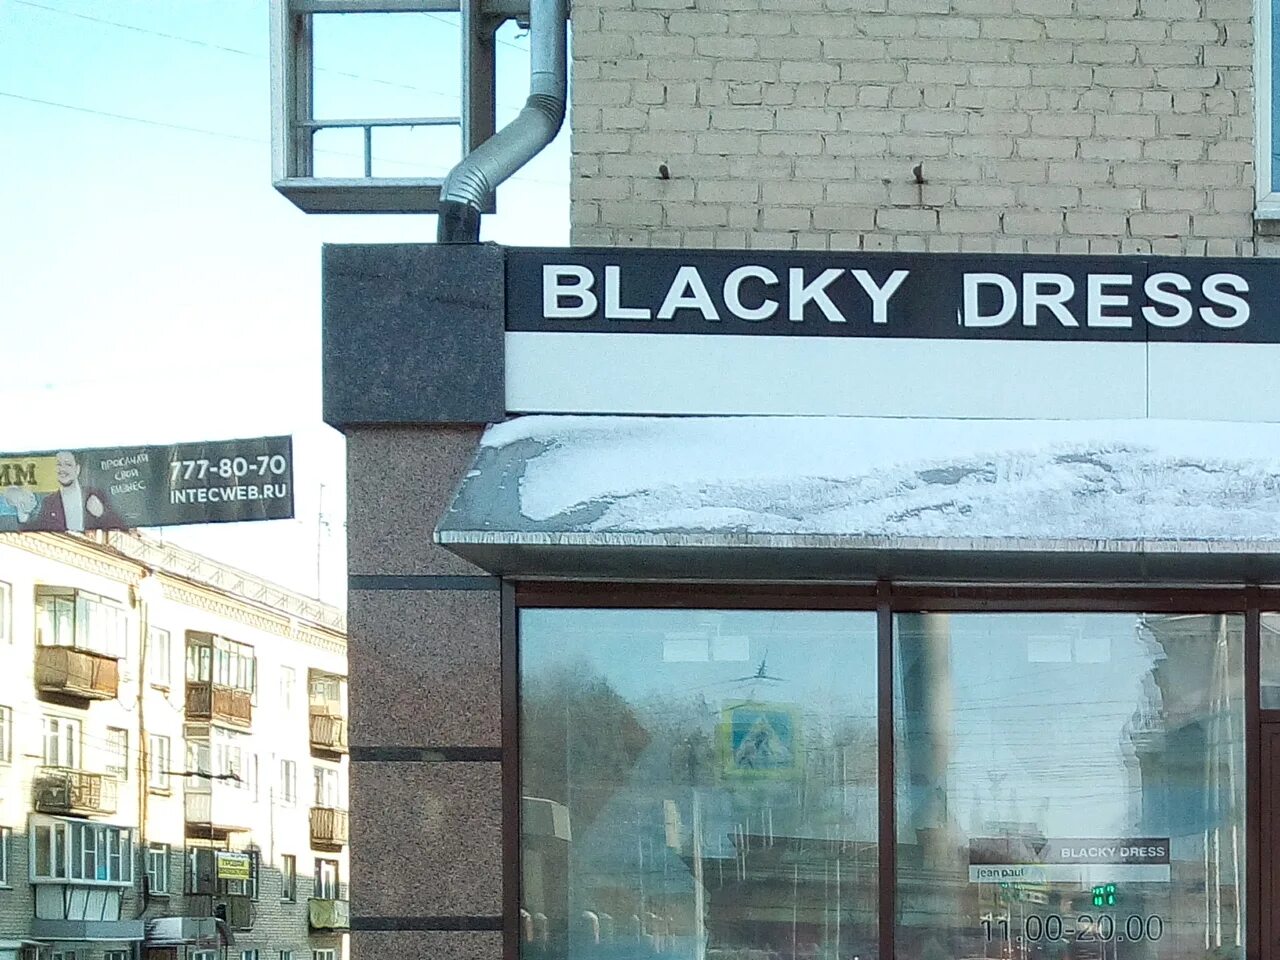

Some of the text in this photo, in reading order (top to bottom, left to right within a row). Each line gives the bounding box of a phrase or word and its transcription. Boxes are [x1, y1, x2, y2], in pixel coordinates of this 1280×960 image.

[543, 264, 1251, 329] BLACKY DRESS
[170, 455, 287, 480] 777-80-70
[170, 483, 287, 505] INTECWEB.RU
[1061, 846, 1165, 859] BLACKY DRESS
[980, 914, 1163, 943] 11.00-20.00
